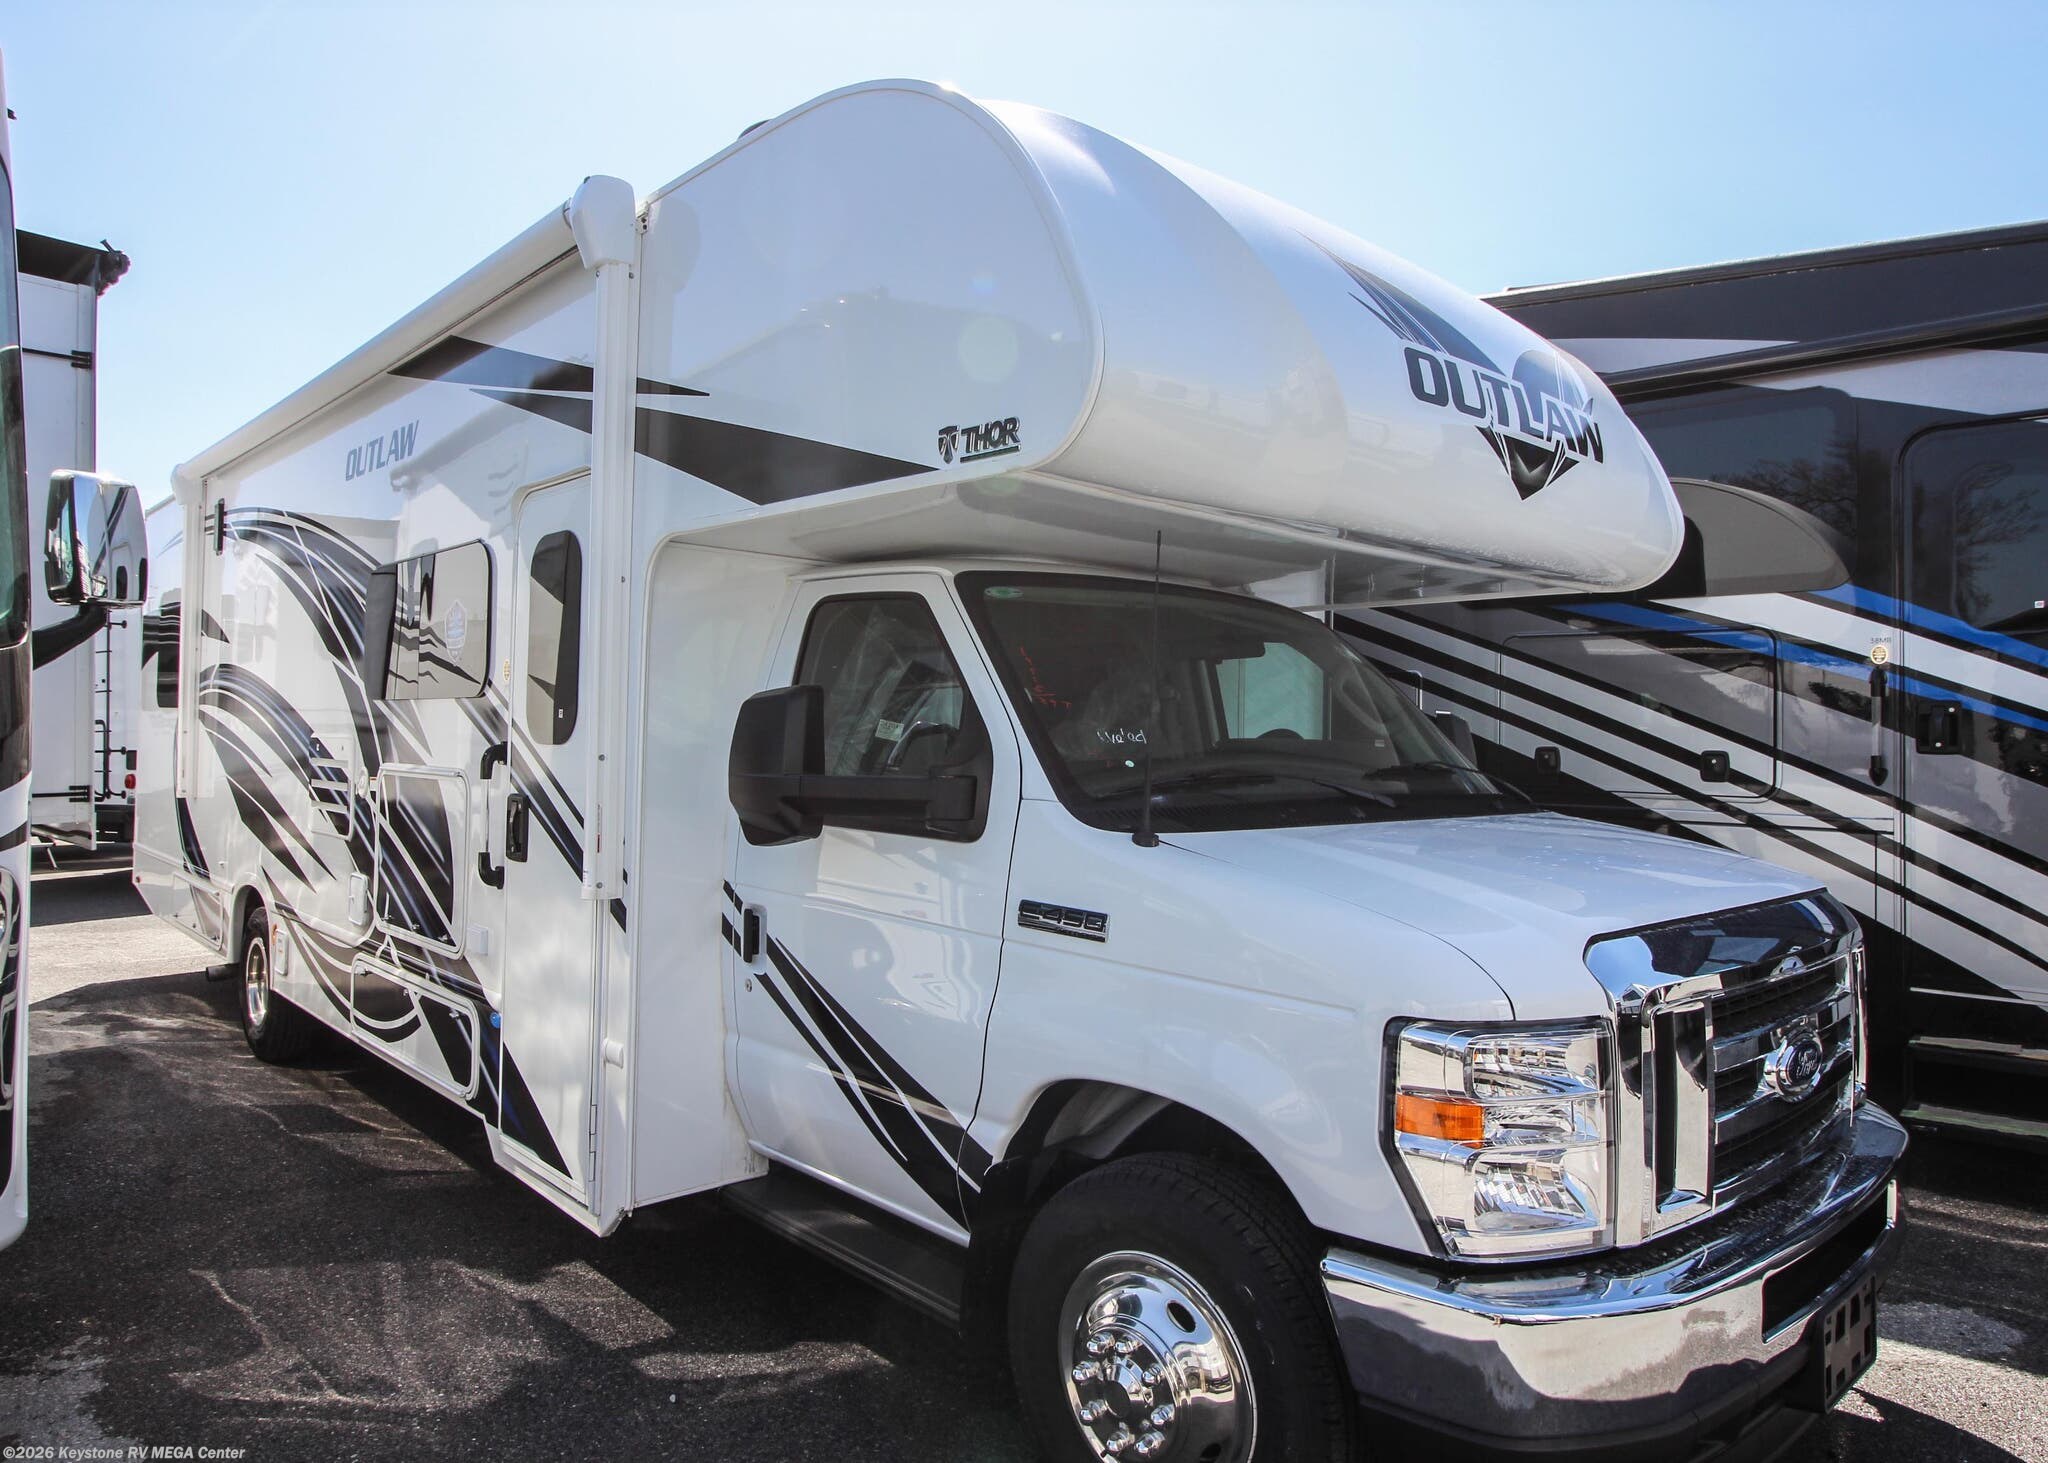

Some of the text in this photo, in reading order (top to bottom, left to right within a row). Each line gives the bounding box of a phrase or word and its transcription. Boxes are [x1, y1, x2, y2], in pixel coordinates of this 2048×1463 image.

[961, 416, 1020, 453] THOR
[1404, 346, 1604, 464] OUTLAW
[345, 419, 420, 481] OUTLAW
